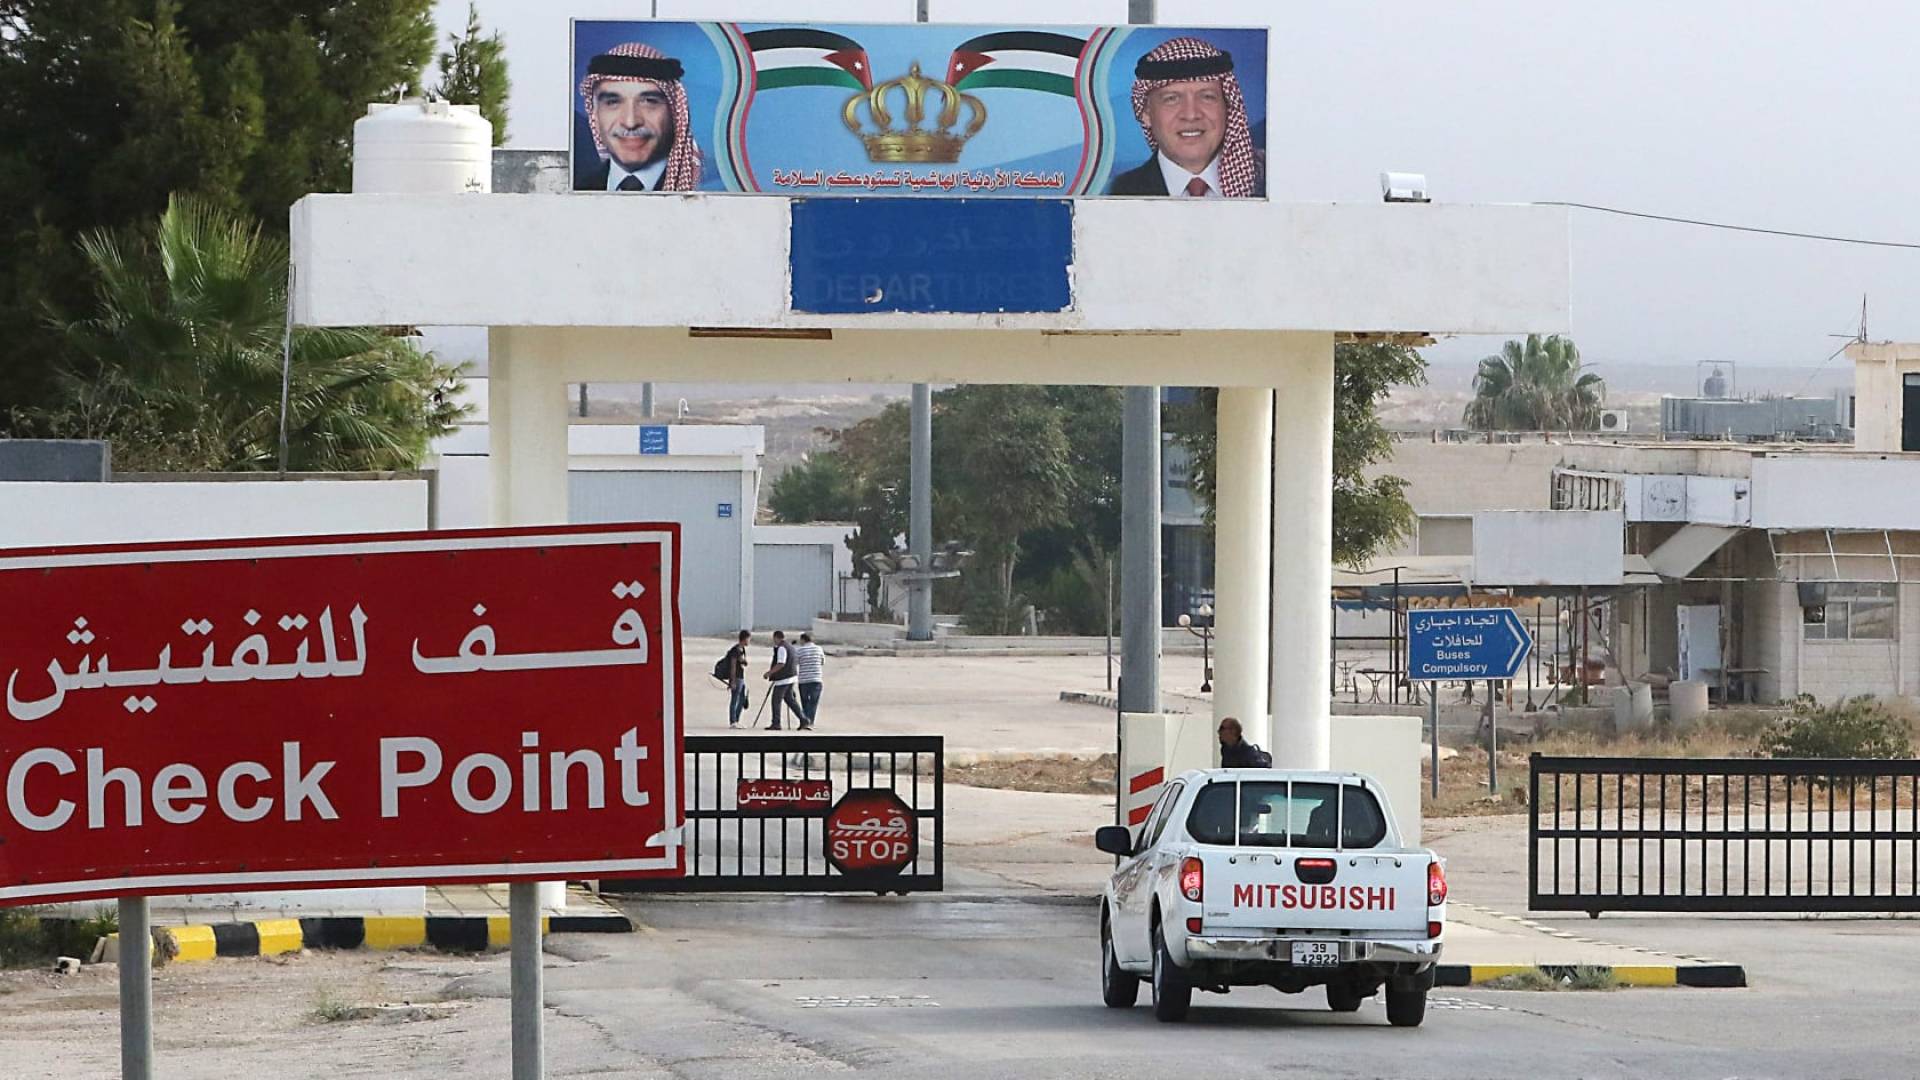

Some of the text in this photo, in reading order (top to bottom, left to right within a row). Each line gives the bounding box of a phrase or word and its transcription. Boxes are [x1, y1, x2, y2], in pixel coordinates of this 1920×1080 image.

[773, 168, 1064, 192] المملكة الأردنية الهاشمية تستودعكم السلامة
[1415, 614, 1498, 633] اتجاه اجباري
[5, 580, 649, 721] قف للتفتيش
[1432, 633, 1483, 648] للحافلات
[1437, 650, 1471, 660] Buses
[1422, 663, 1488, 674] Compulsory
[6, 726, 650, 832] Check Point
[738, 785, 830, 805] قف للتفتيش
[836, 808, 907, 833] قف
[832, 840, 909, 861] STOP
[1233, 884, 1395, 911] MITSUBISHI
[1312, 943, 1327, 953] 39
[1301, 954, 1338, 965] 42922
